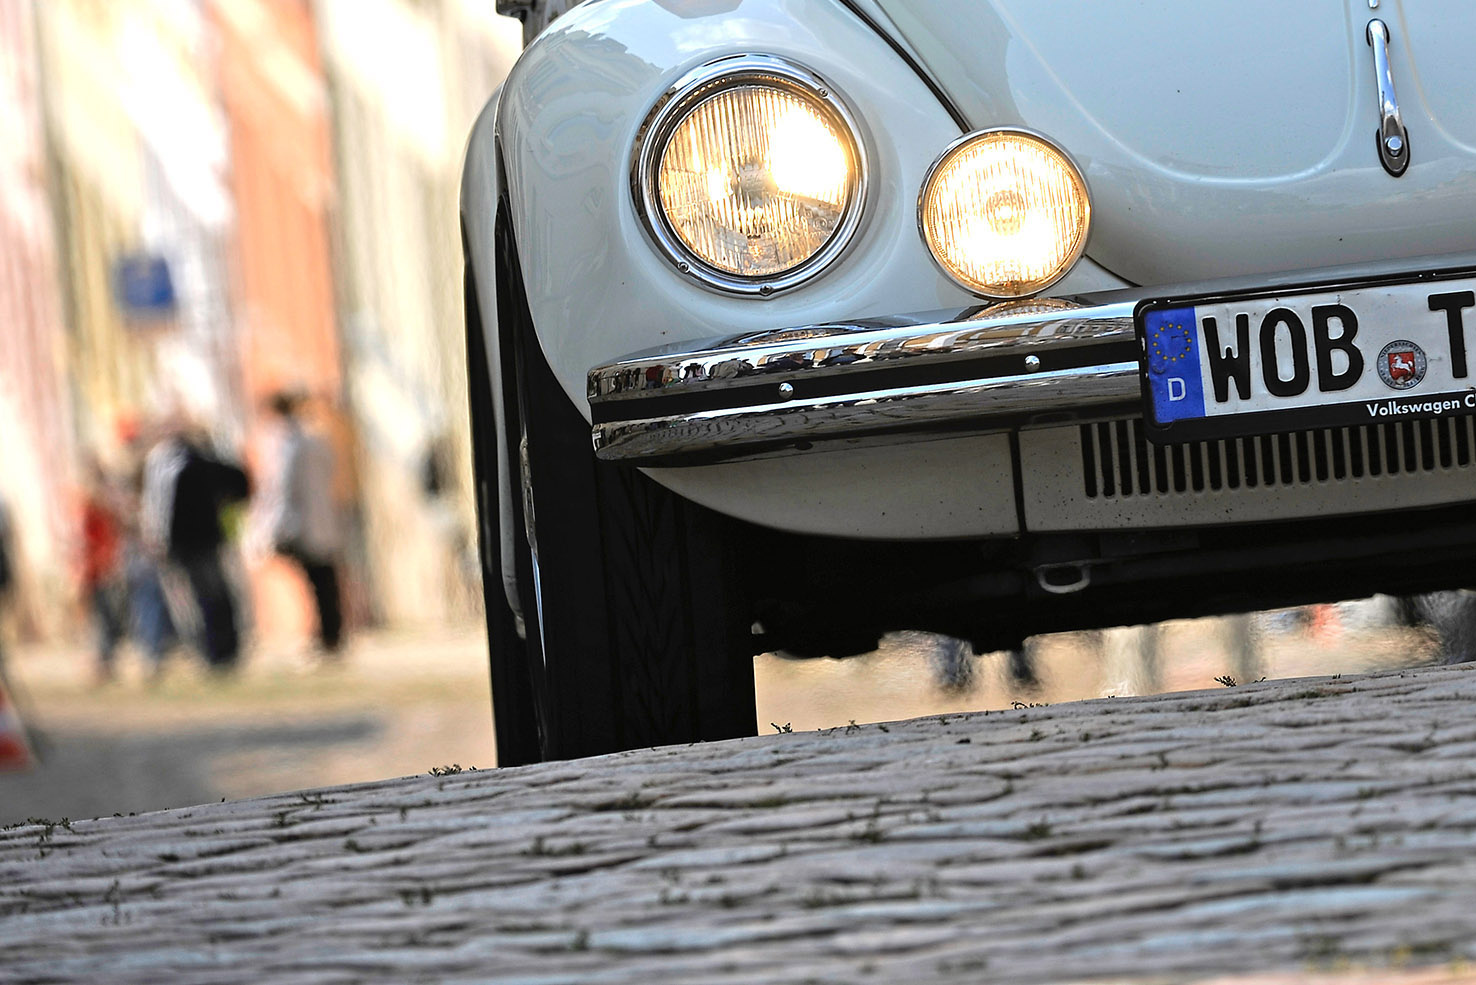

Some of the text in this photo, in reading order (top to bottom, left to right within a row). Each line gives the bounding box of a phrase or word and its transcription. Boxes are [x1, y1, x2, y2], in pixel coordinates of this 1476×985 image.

[1201, 304, 1364, 403] WOB
[1167, 376, 1186, 402] D
[1366, 400, 1460, 417] Volkswagen
